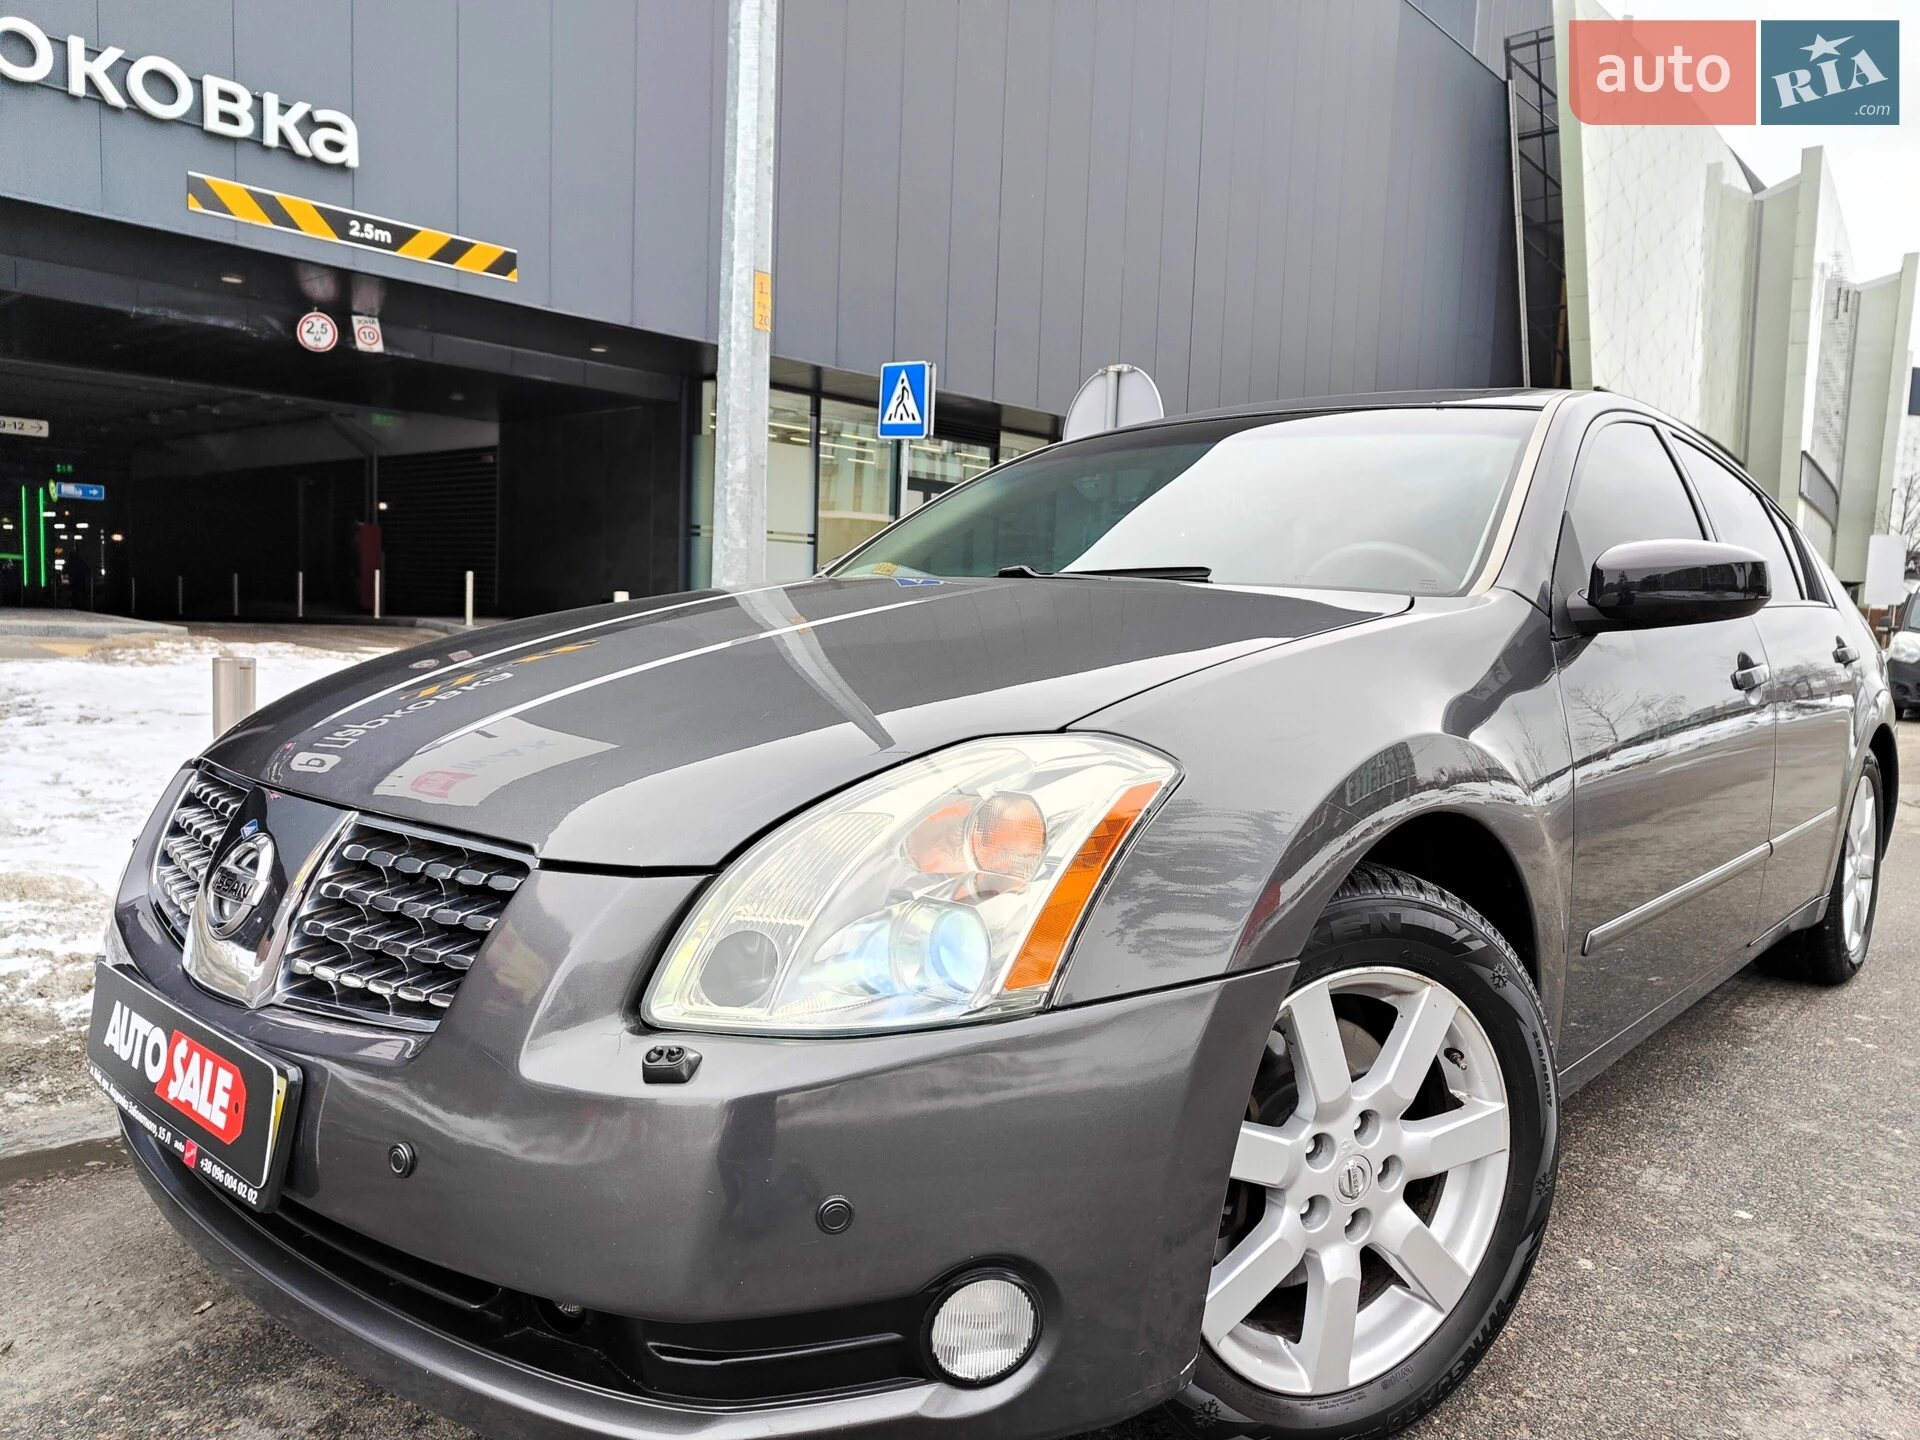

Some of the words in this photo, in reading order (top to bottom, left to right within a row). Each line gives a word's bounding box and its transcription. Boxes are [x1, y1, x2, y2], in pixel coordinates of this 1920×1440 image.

[349, 219, 392, 244] 2.5m
[306, 321, 328, 335] 2,5
[362, 331, 375, 340] 10
[103, 999, 168, 1083] AUTO
[200, 1158, 213, 1174] +38
[211, 1164, 225, 1183] 096
[224, 1173, 238, 1192] 004
[237, 1181, 248, 1199] 02
[247, 1188, 258, 1205] 02
